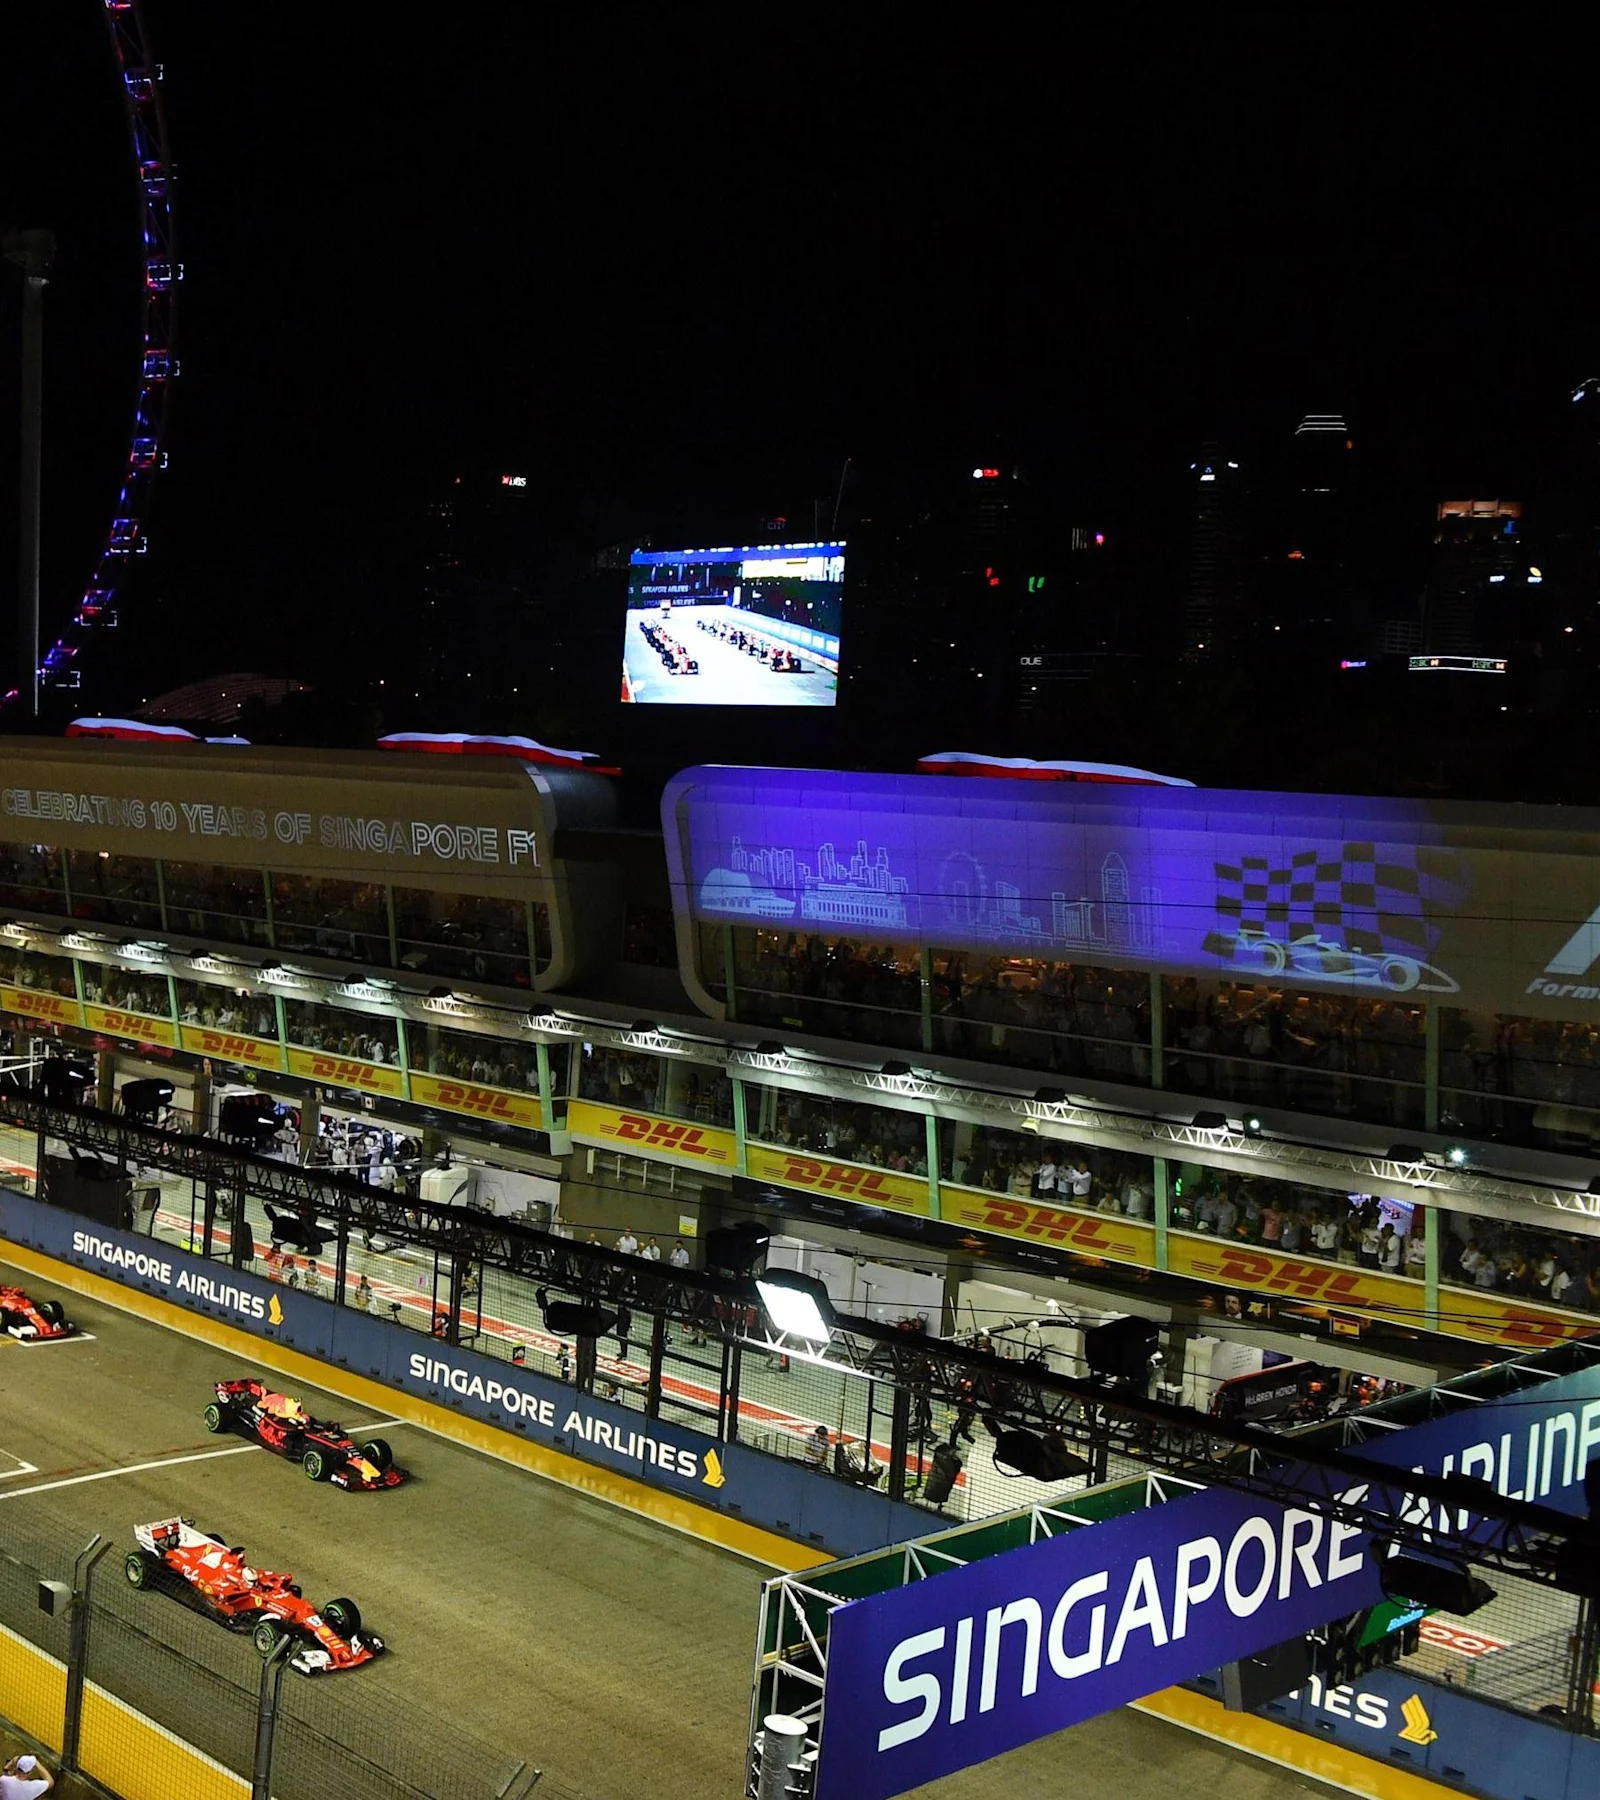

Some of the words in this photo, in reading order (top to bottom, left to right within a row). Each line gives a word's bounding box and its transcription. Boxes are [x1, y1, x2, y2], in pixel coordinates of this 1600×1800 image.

[1019, 656, 1043, 666] OUE
[2, 787, 144, 828] CELEBRATING
[151, 801, 177, 831] 10
[181, 804, 267, 840] YEARS
[274, 811, 311, 845] OF
[320, 815, 499, 862] SINGAPORE
[507, 829, 540, 867] F1
[17, 992, 64, 1017] DHL
[104, 1012, 157, 1039] DHL
[202, 1031, 262, 1061] DHL
[311, 1055, 380, 1088] DHL
[438, 1083, 519, 1121] DHL
[619, 1114, 709, 1155] DHL
[784, 1158, 890, 1201] DHL
[982, 1200, 1111, 1250] DHL
[73, 1231, 171, 1285] SINGAPORE
[177, 1270, 265, 1320] AIRLINES
[1218, 1250, 1372, 1308] DHL
[409, 1353, 555, 1428] SINGAPORE
[563, 1410, 698, 1479] AIRLINES
[878, 1483, 1370, 1752] SINGAPORE
